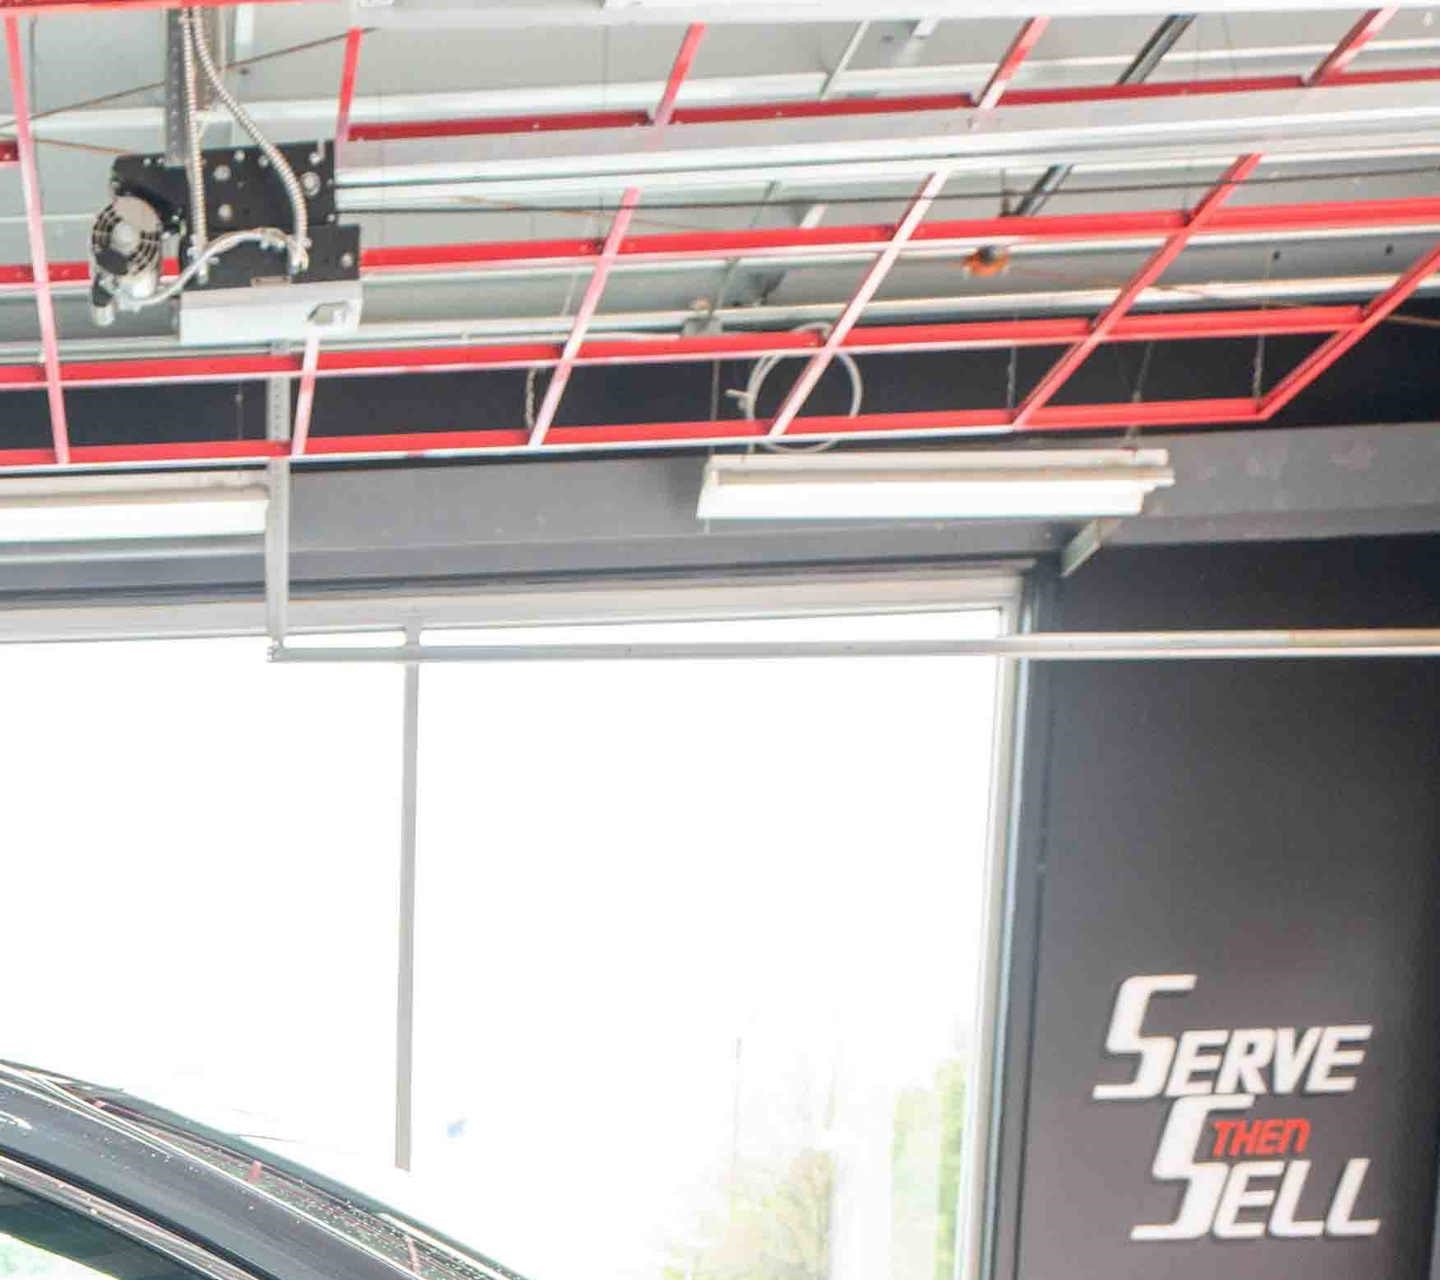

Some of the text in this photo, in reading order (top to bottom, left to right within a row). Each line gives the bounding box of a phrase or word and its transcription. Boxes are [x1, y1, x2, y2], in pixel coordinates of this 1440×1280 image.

[1092, 974, 1372, 1099] SERVE
[1131, 1094, 1380, 1240] SELL
[1213, 1118, 1311, 1156] THEN
